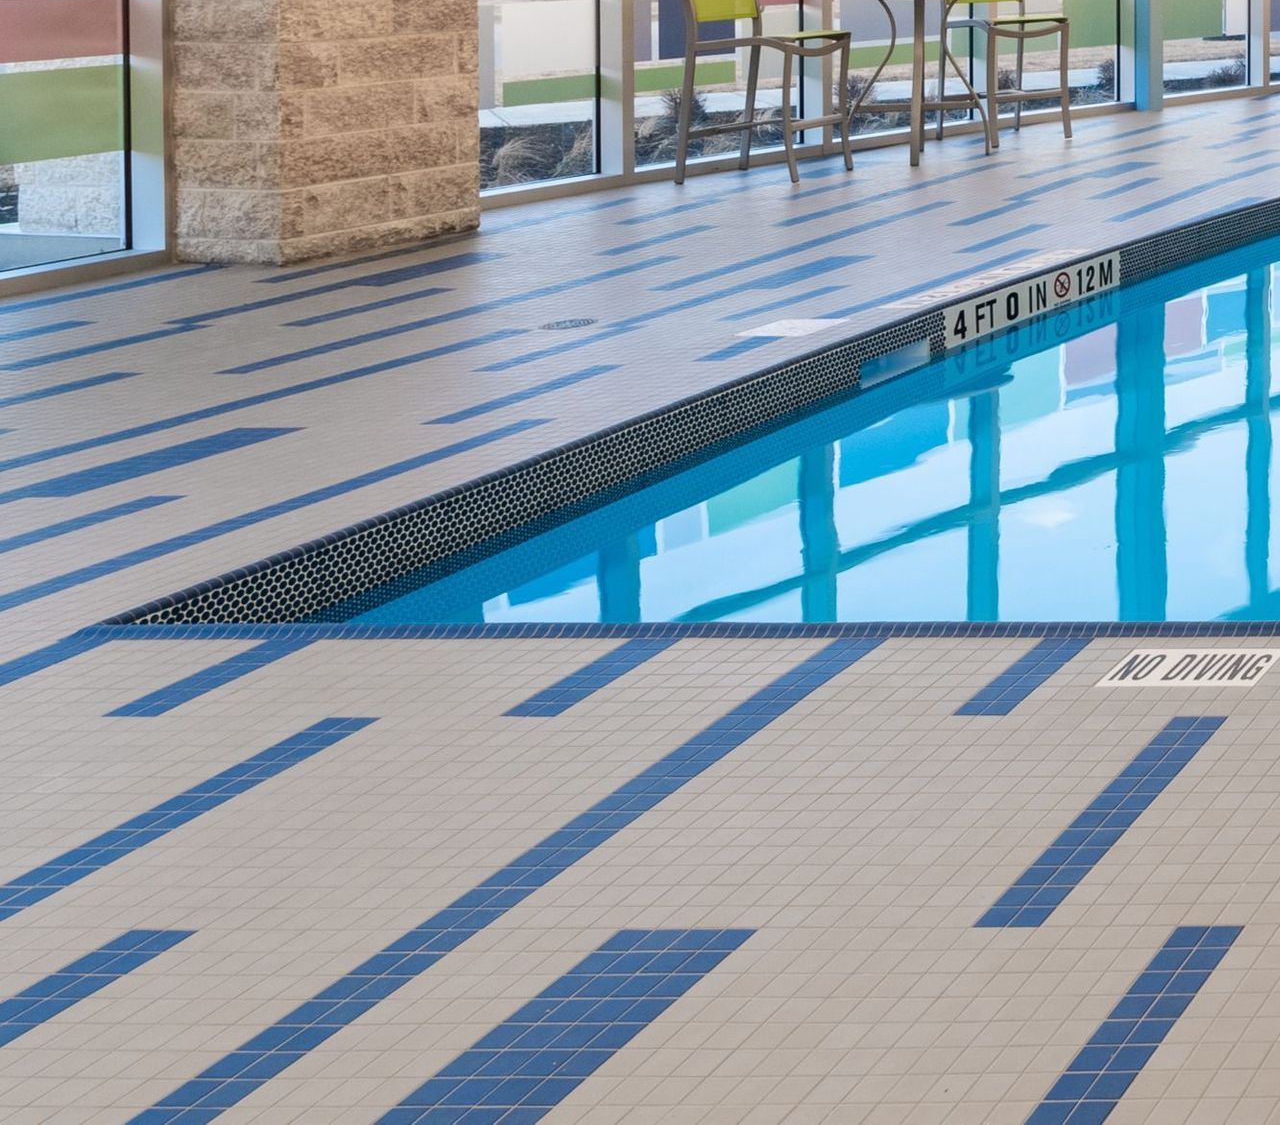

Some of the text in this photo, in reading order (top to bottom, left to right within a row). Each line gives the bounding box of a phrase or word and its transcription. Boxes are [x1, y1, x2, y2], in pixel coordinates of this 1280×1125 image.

[953, 310, 967, 339] 4
[975, 299, 997, 333] FT
[1006, 292, 1019, 320] 0
[1028, 281, 1047, 314] IN
[1108, 654, 1273, 681] NO DIVING
